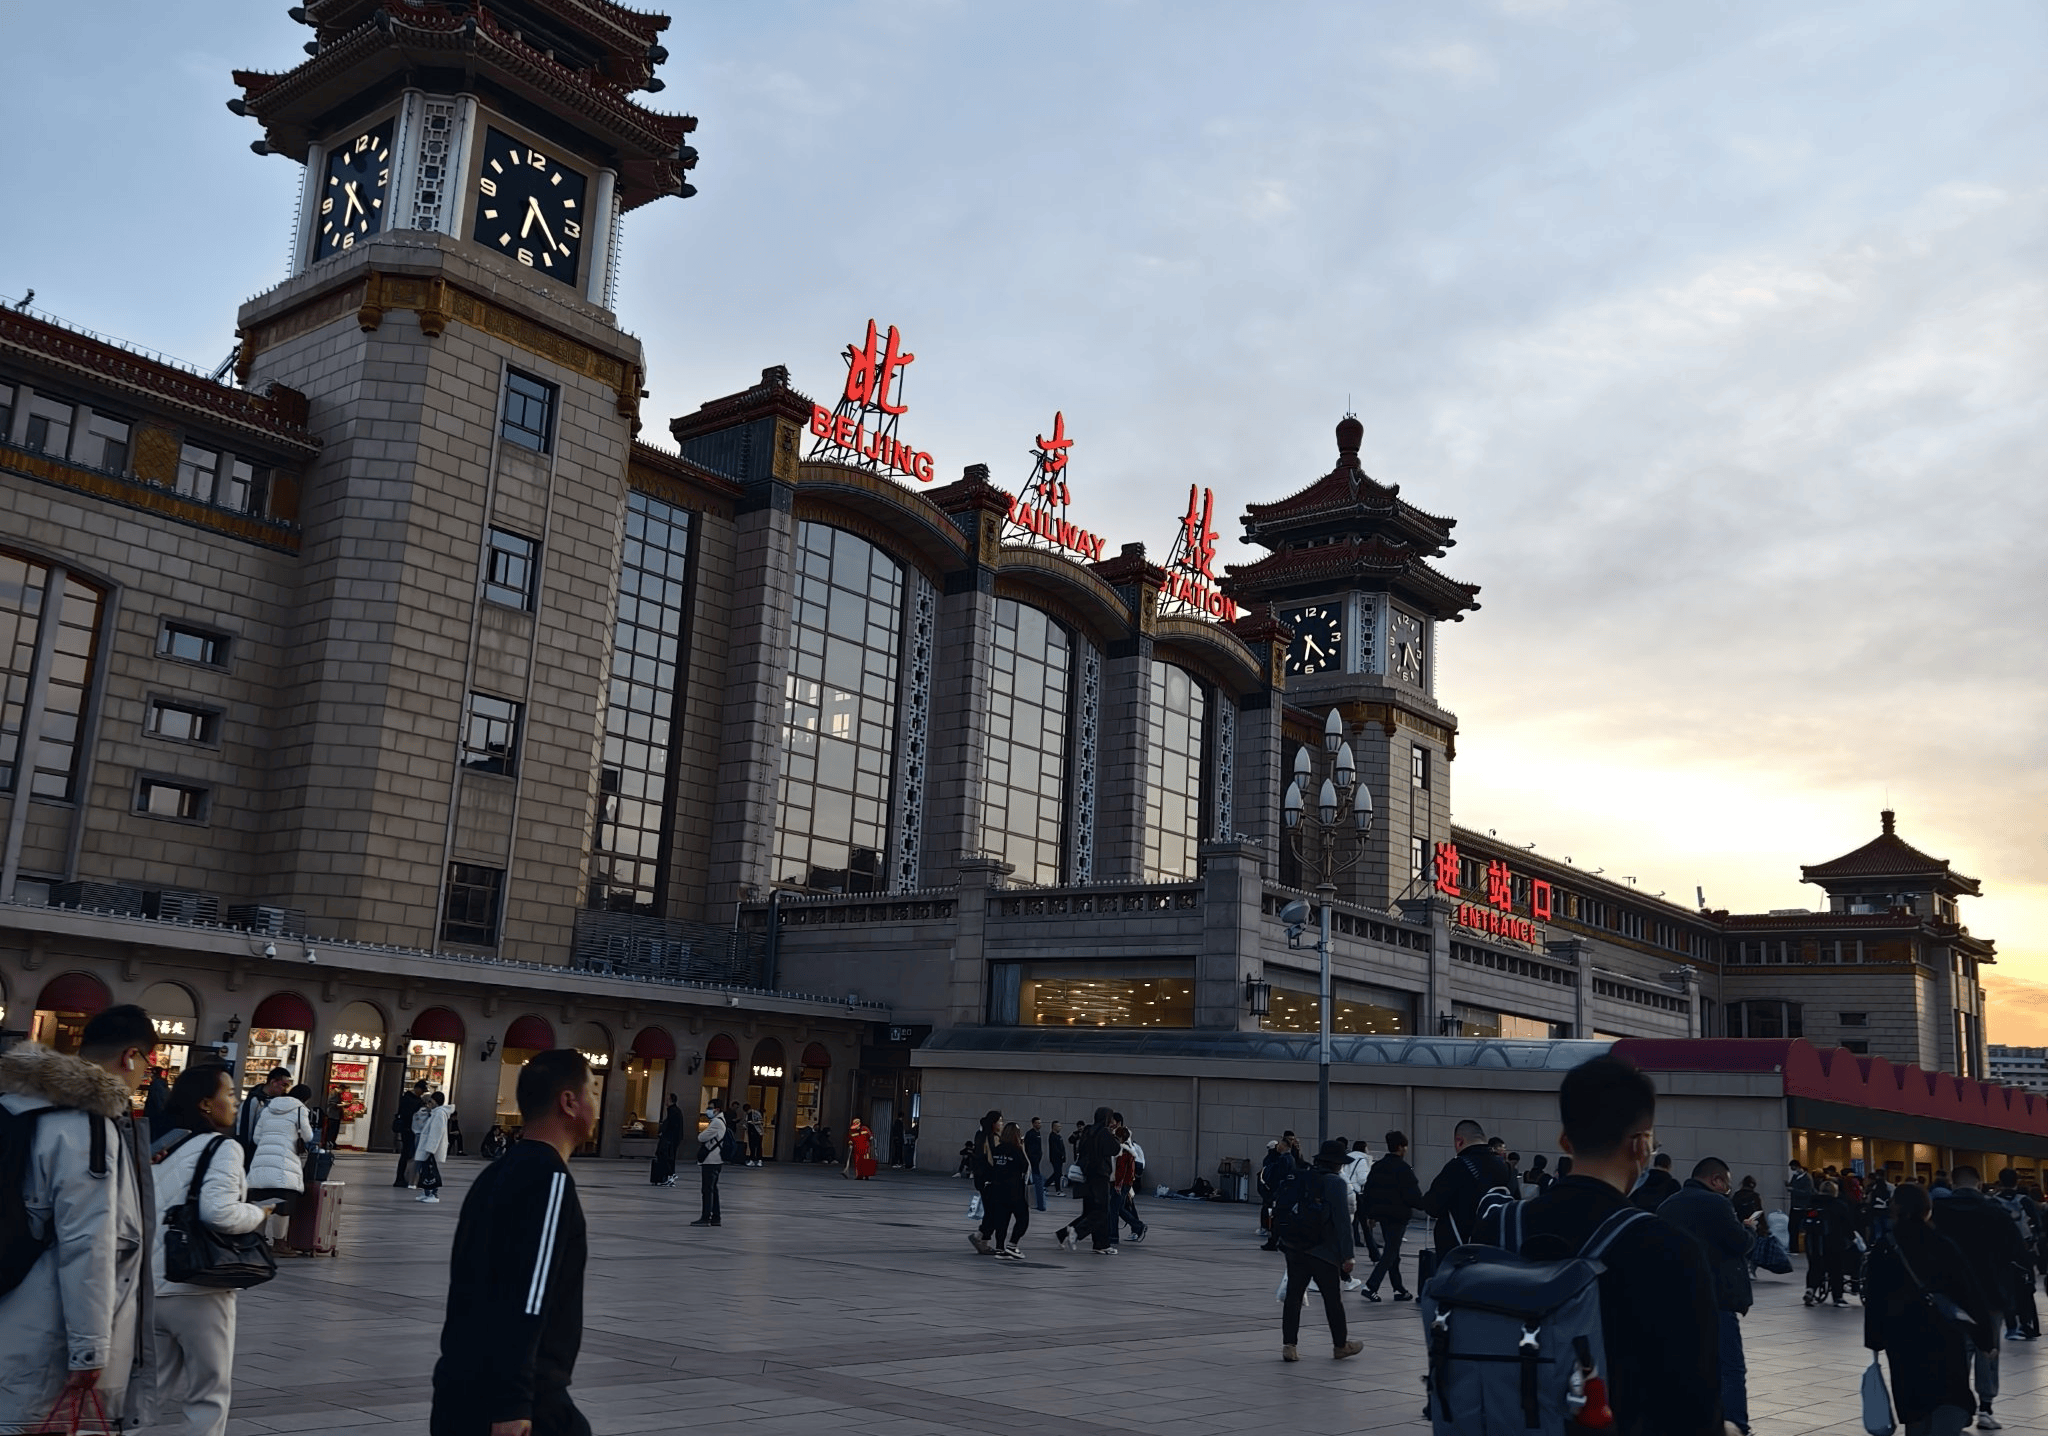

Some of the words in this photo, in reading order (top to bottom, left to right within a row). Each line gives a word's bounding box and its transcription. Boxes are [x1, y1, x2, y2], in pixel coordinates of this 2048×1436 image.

[355, 134, 368, 153] 12
[527, 149, 546, 171] 12
[378, 169, 388, 187] 3
[480, 177, 497, 197] 9
[322, 198, 333, 215] 9
[564, 218, 581, 239] 3
[343, 232, 354, 249] 6
[518, 248, 533, 267] 6
[845, 318, 915, 415] 北
[1036, 411, 1073, 507] 京
[810, 404, 934, 482] BEIJING
[1305, 607, 1317, 618] 12
[1331, 632, 1341, 642] 3
[1305, 664, 1315, 674] 6
[1435, 841, 1552, 921] 进站口
[1458, 903, 1537, 944] ENTRANCE
